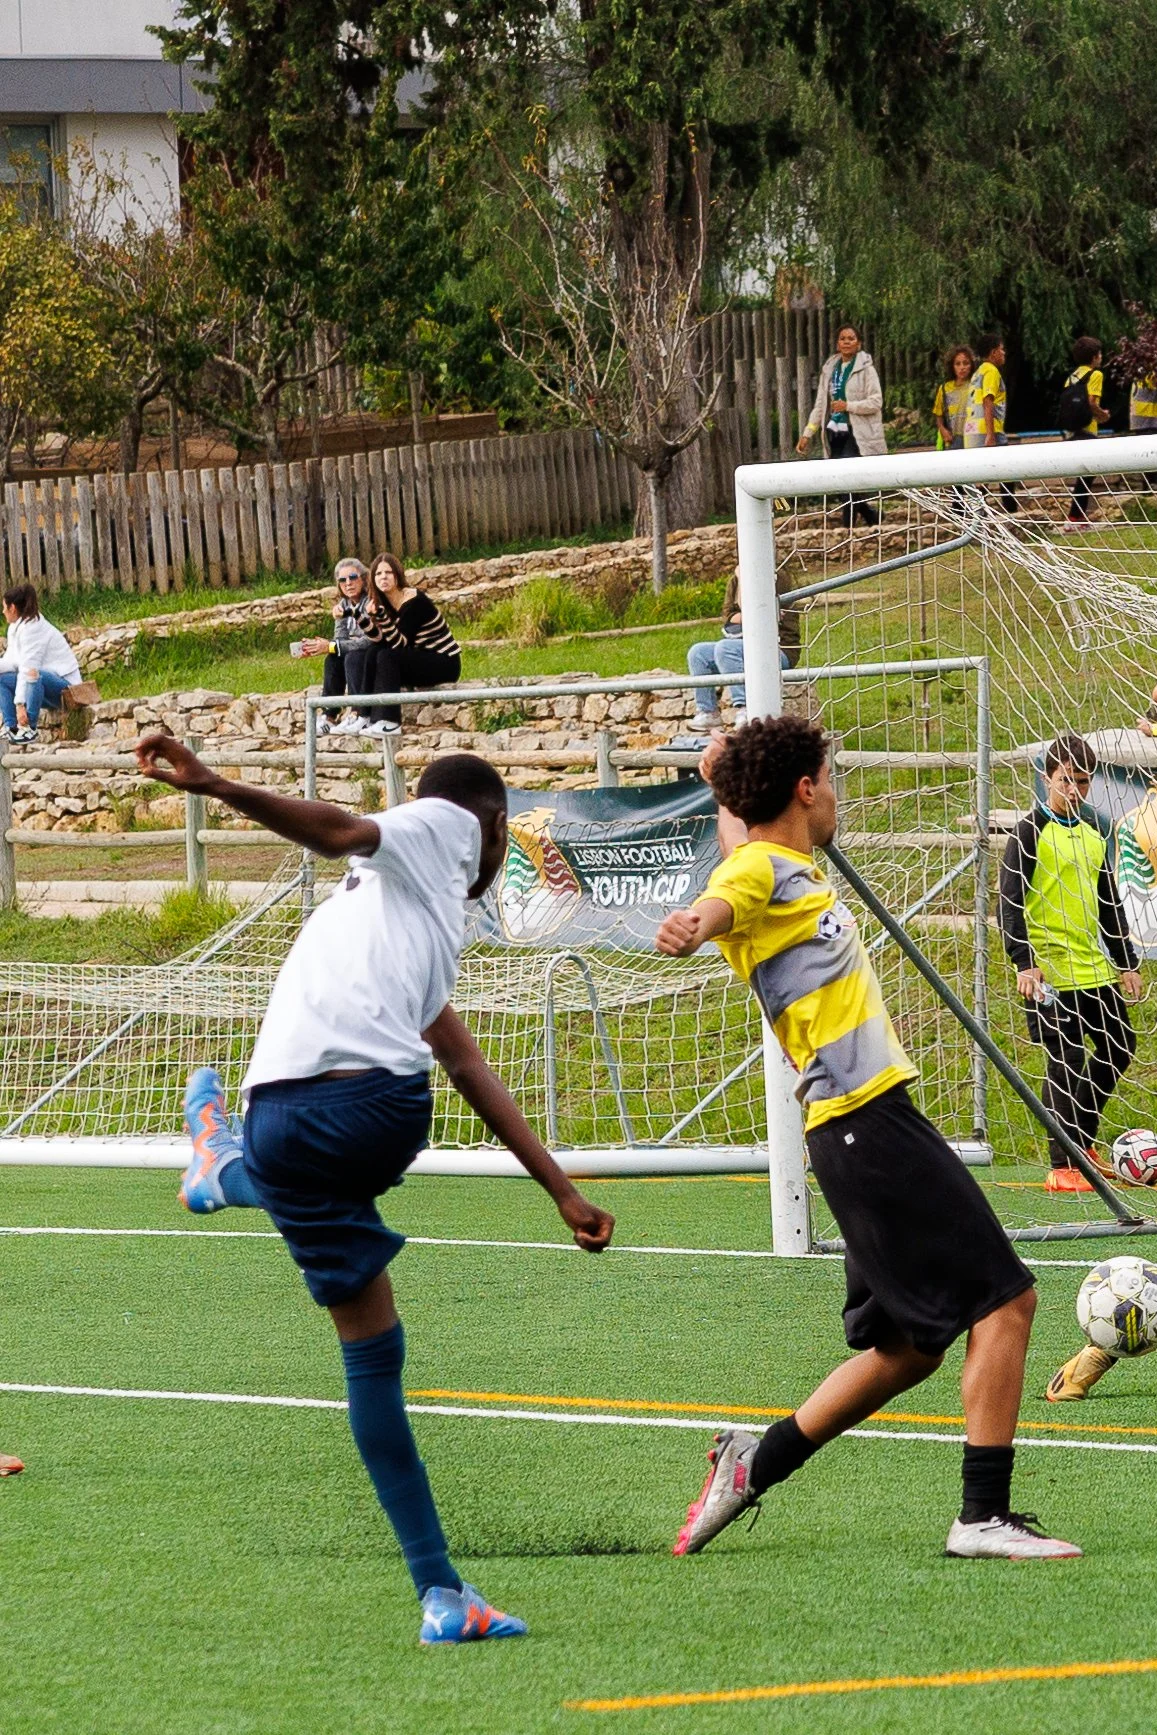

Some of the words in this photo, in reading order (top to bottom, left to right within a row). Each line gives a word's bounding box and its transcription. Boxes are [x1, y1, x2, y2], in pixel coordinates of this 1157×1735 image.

[573, 848, 622, 868] LISBON
[620, 841, 696, 866] FOOTBALL
[585, 876, 654, 906] YOUTH
[653, 874, 692, 904] CUP
